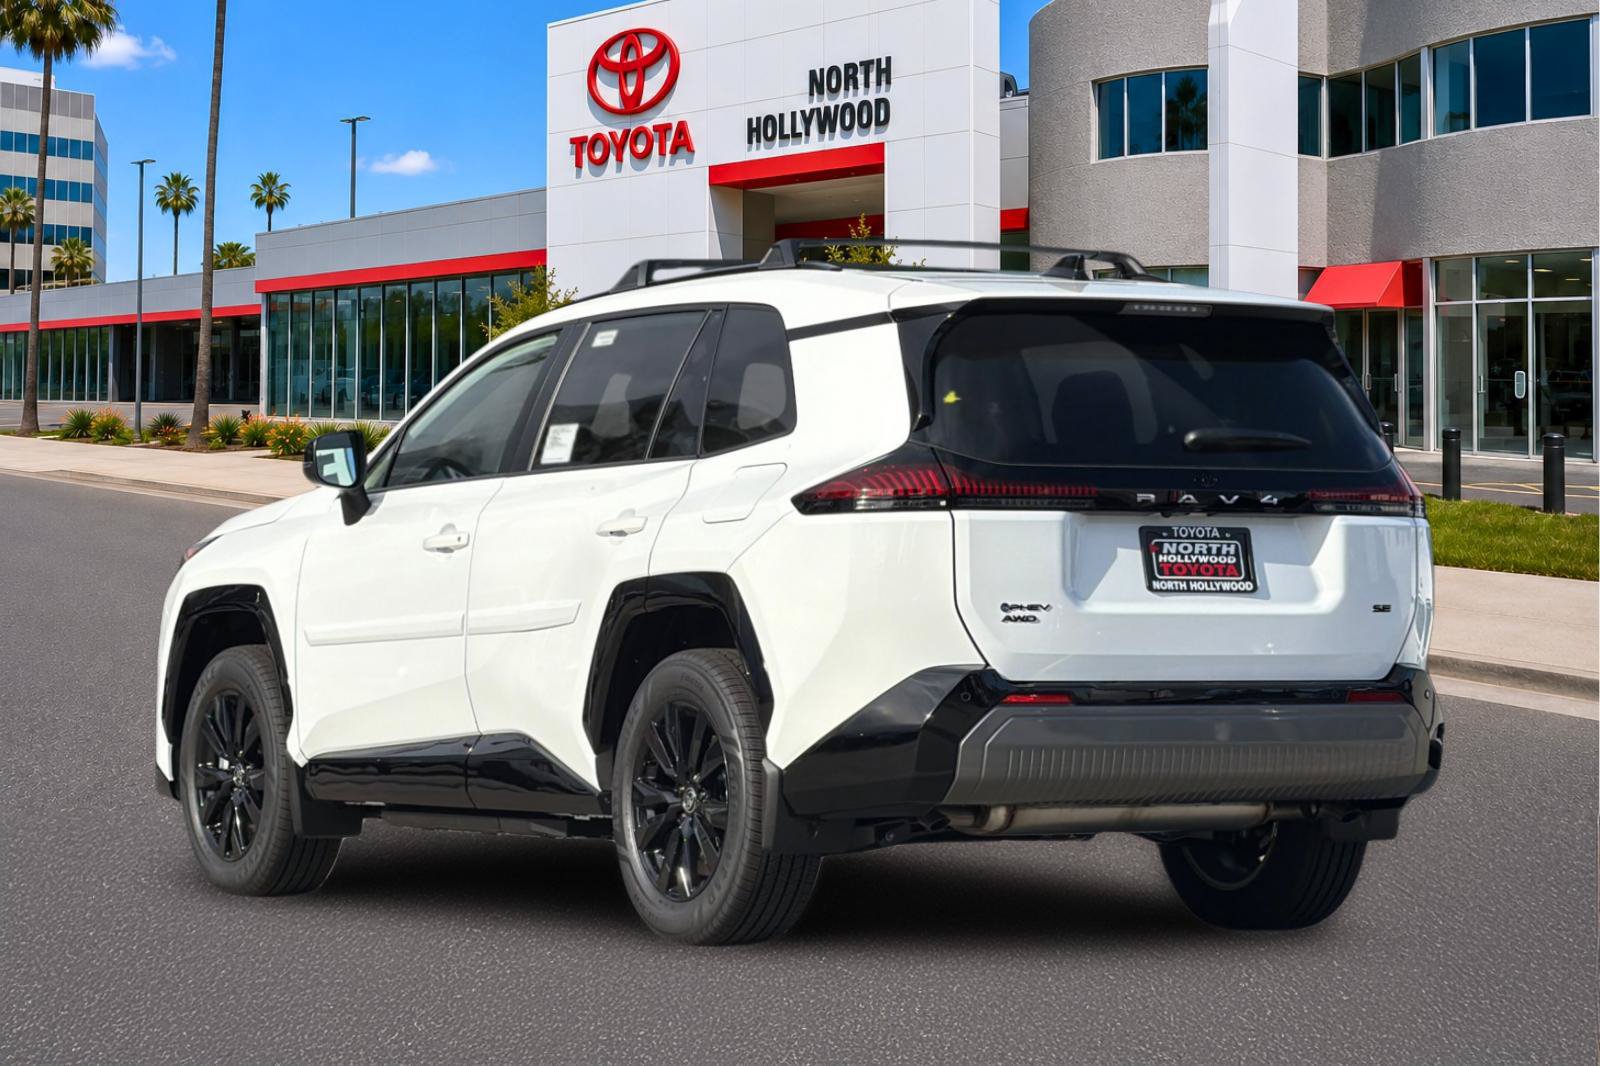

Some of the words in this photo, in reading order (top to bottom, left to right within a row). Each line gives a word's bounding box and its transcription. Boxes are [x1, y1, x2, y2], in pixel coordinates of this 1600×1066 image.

[809, 55, 892, 97] NORTH
[747, 97, 891, 145] HOLLYWOOD
[570, 120, 695, 168] TOYOTA
[1136, 493, 1279, 505] RAV4
[1172, 527, 1220, 538] TOYOTA
[1162, 543, 1236, 554] NORTH
[1158, 555, 1236, 563] HOLLYWOOD
[1160, 563, 1239, 577] TOYOTA
[1152, 580, 1188, 591] NORTH
[1190, 581, 1254, 592] HOLLYWOOD
[1372, 605, 1392, 613] SE
[1001, 615, 1038, 623] AWD
